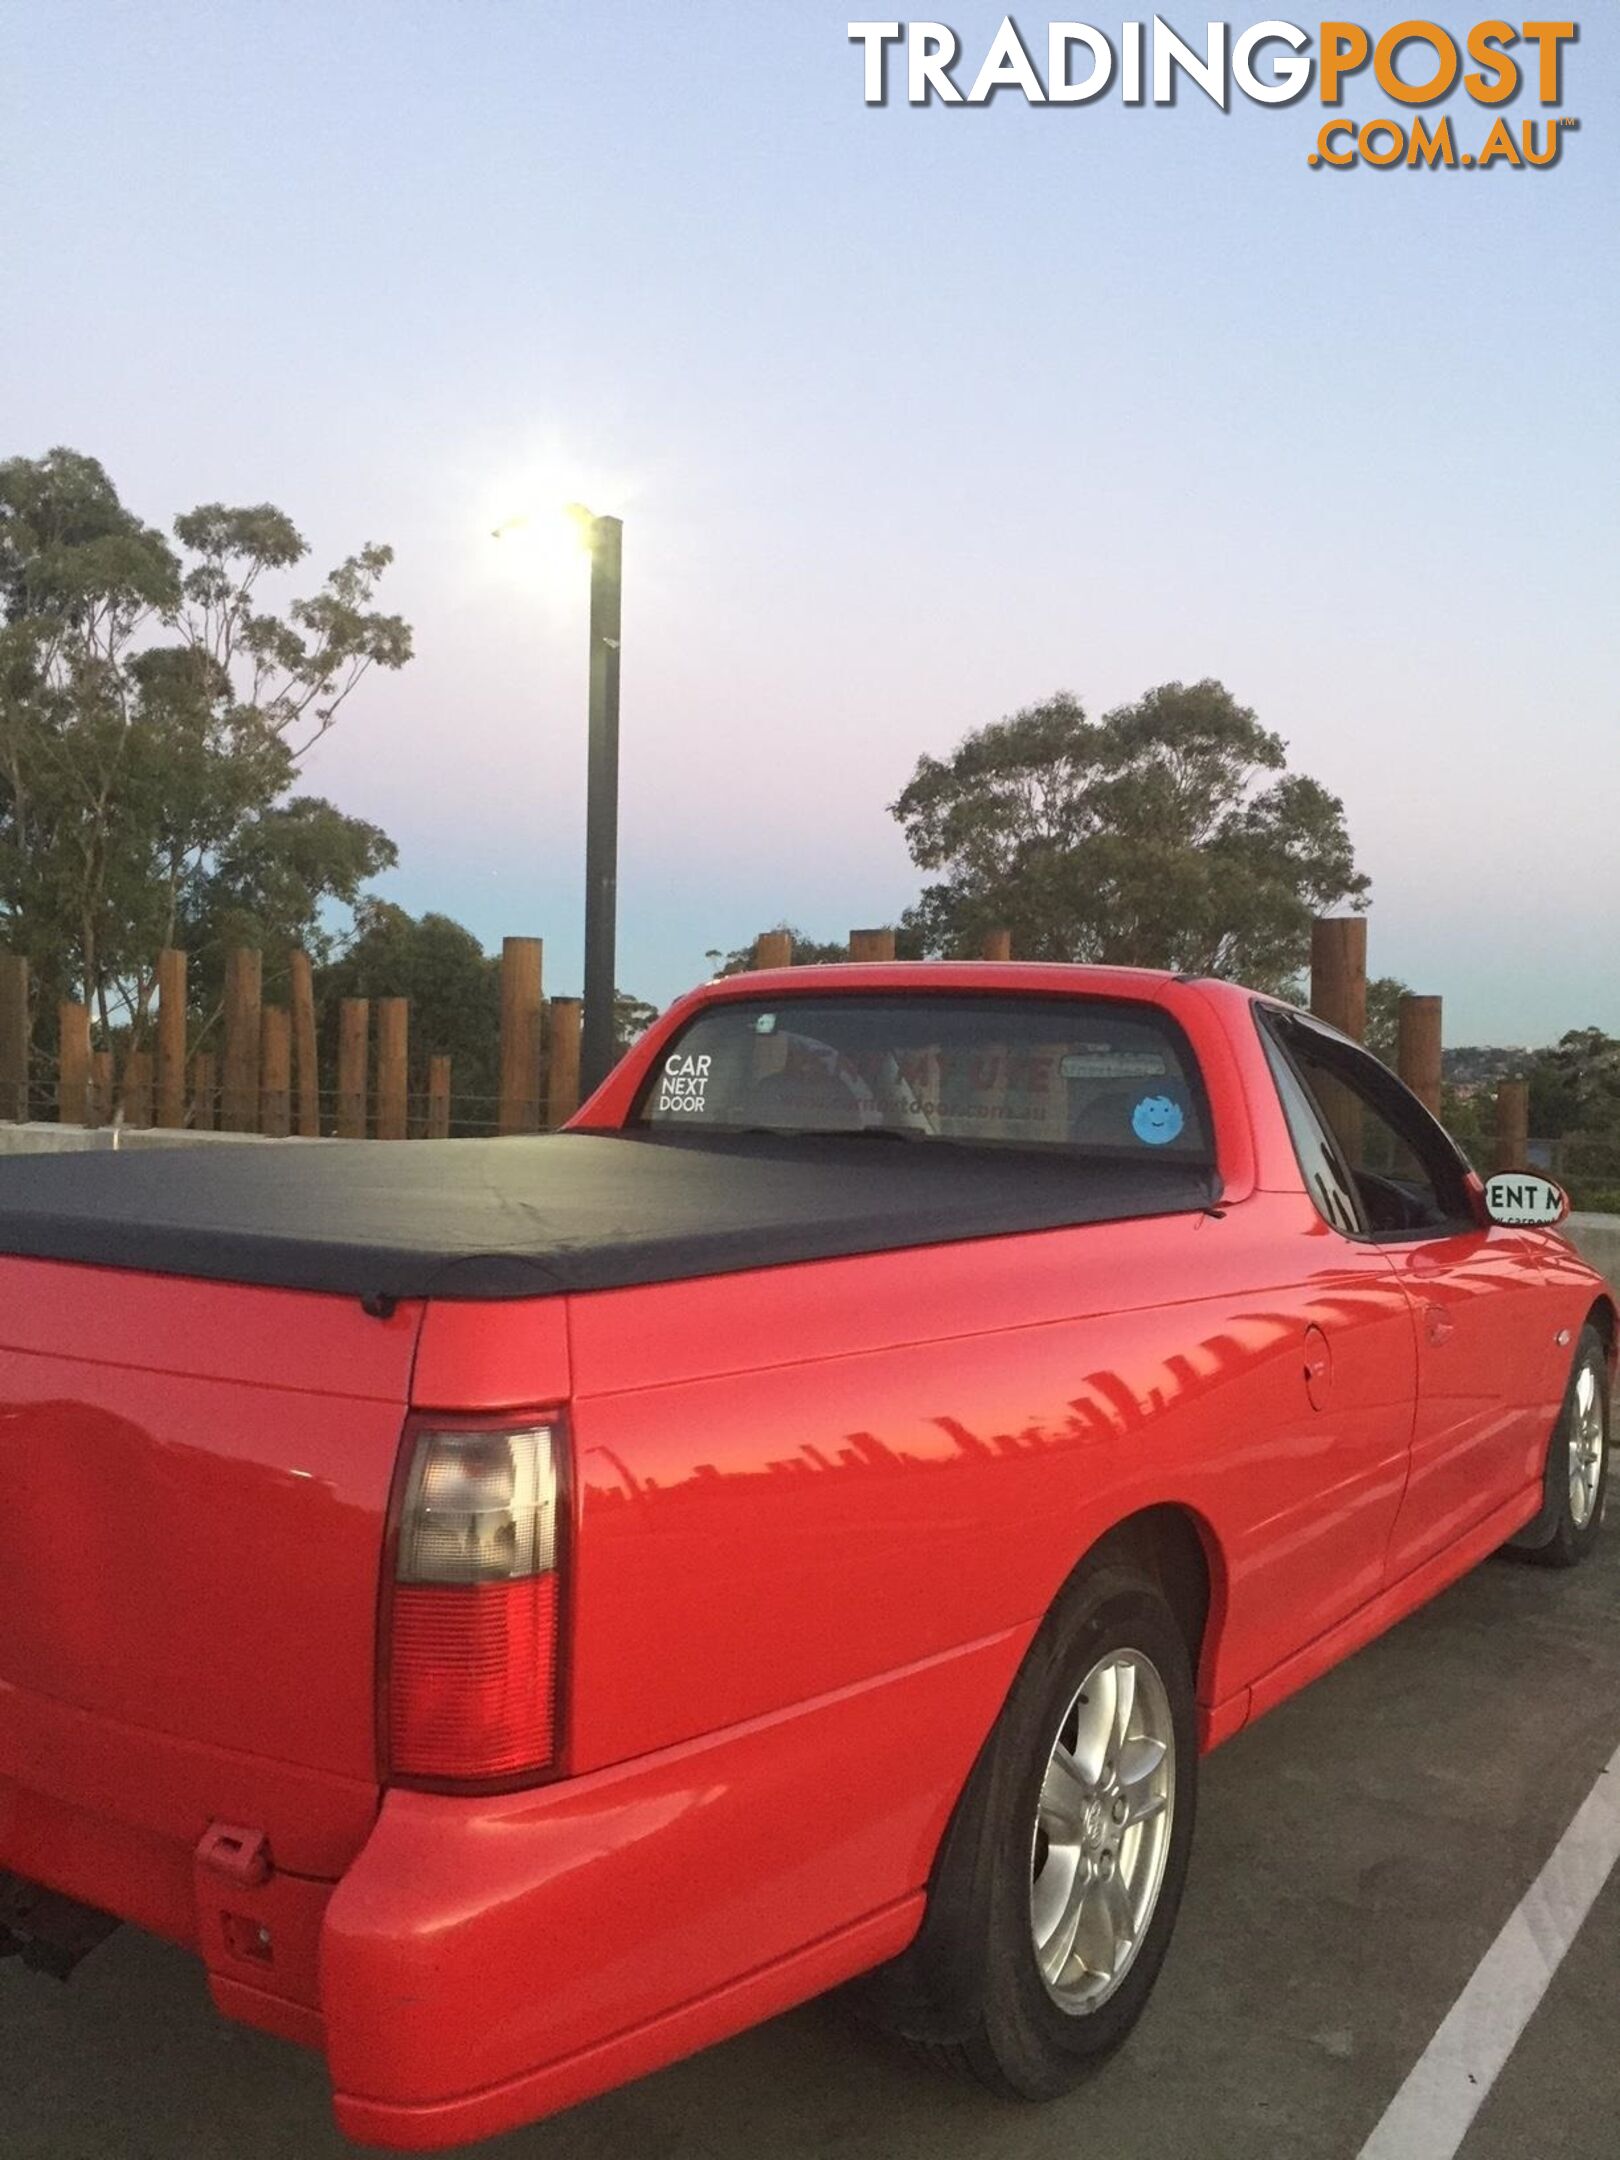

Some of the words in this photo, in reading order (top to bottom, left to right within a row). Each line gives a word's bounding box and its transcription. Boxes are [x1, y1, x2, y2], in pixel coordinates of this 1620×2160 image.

[665, 1054, 712, 1077] CAR
[661, 1077, 709, 1096] NEXT
[659, 1096, 705, 1112] DOOR
[1485, 1185, 1538, 1209] ENT
